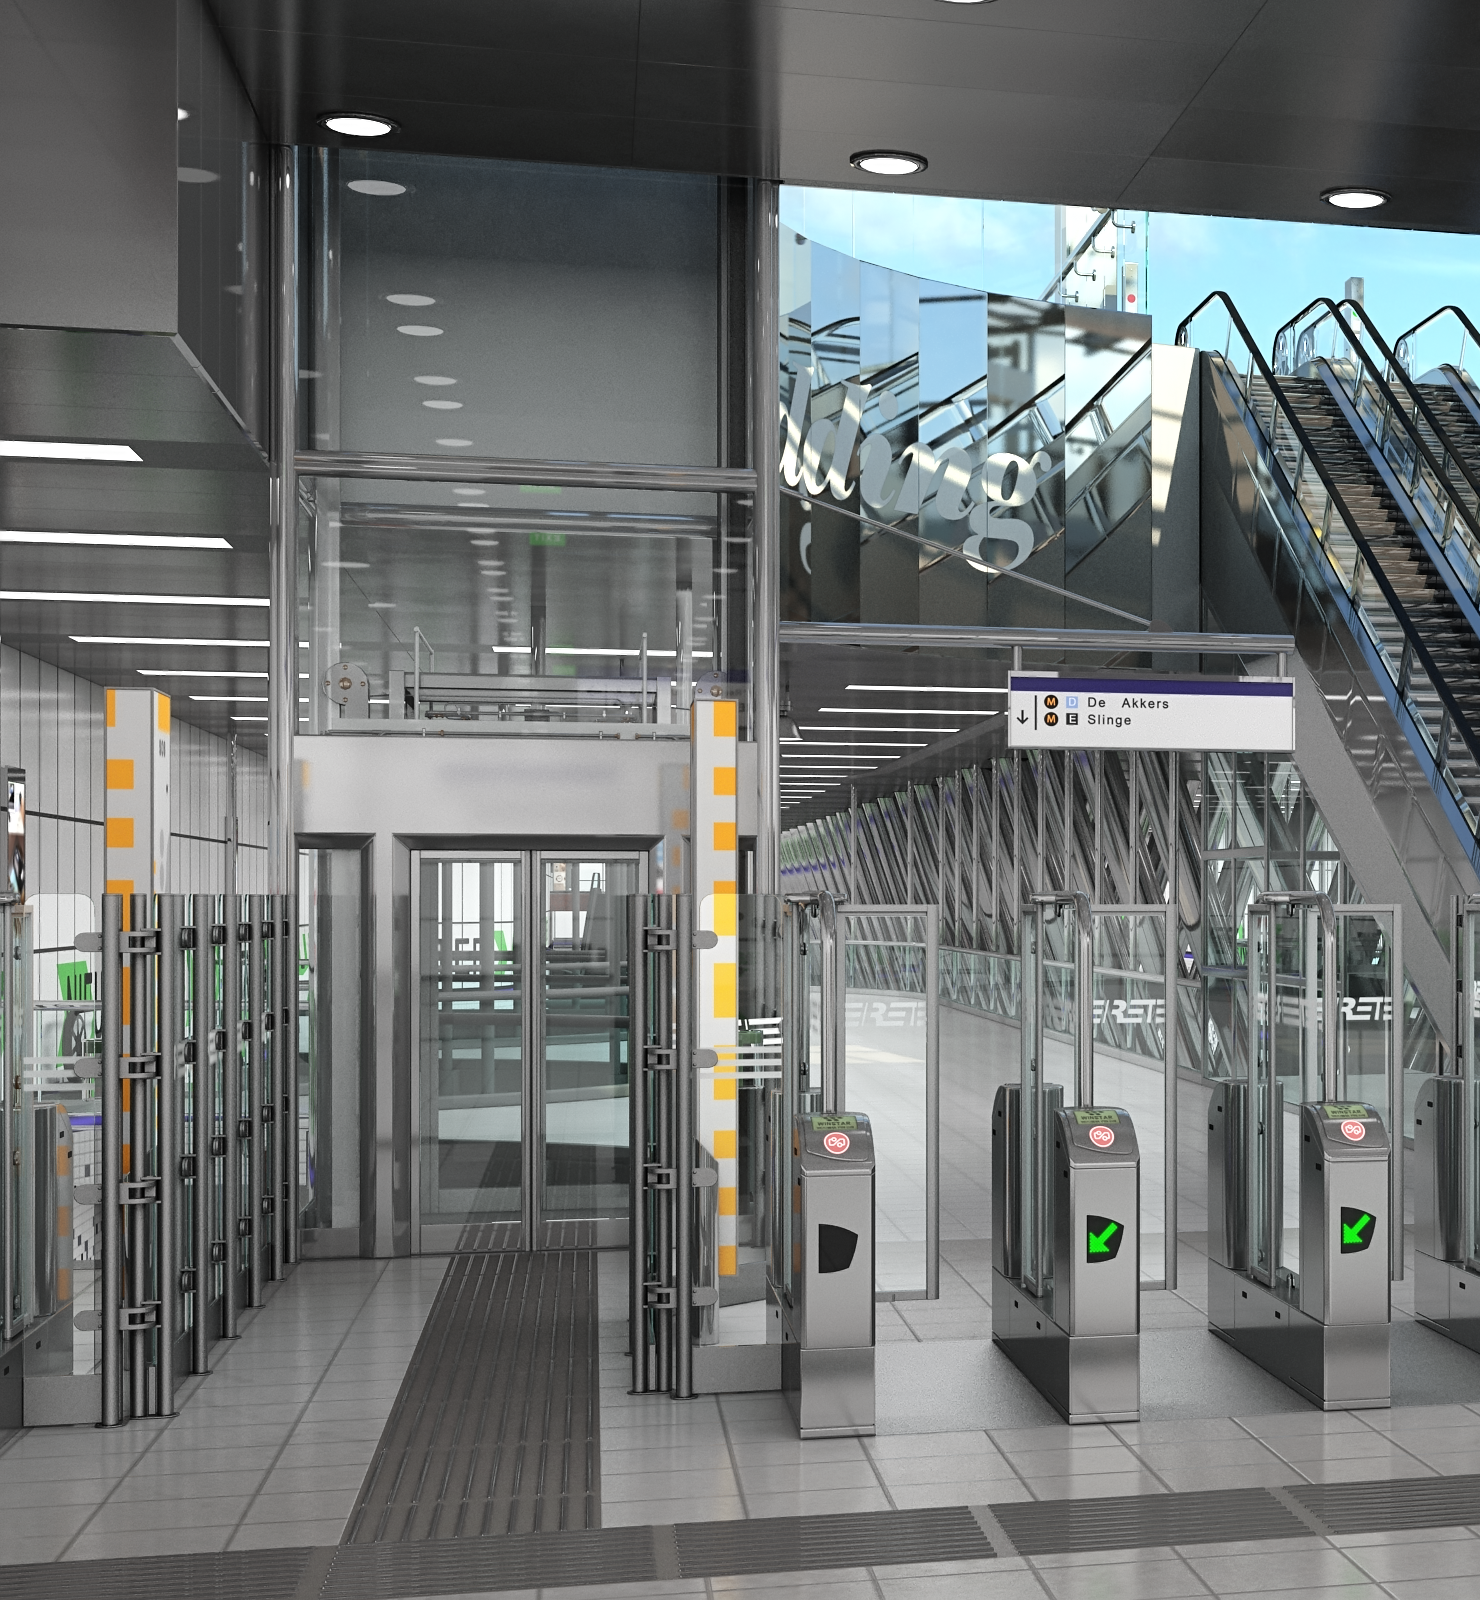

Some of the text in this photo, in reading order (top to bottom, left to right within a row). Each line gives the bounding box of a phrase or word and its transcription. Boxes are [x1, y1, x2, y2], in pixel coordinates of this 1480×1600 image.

[1087, 697, 1106, 709] De
[1121, 697, 1170, 710] Akkers
[1087, 714, 1132, 728] Slinge
